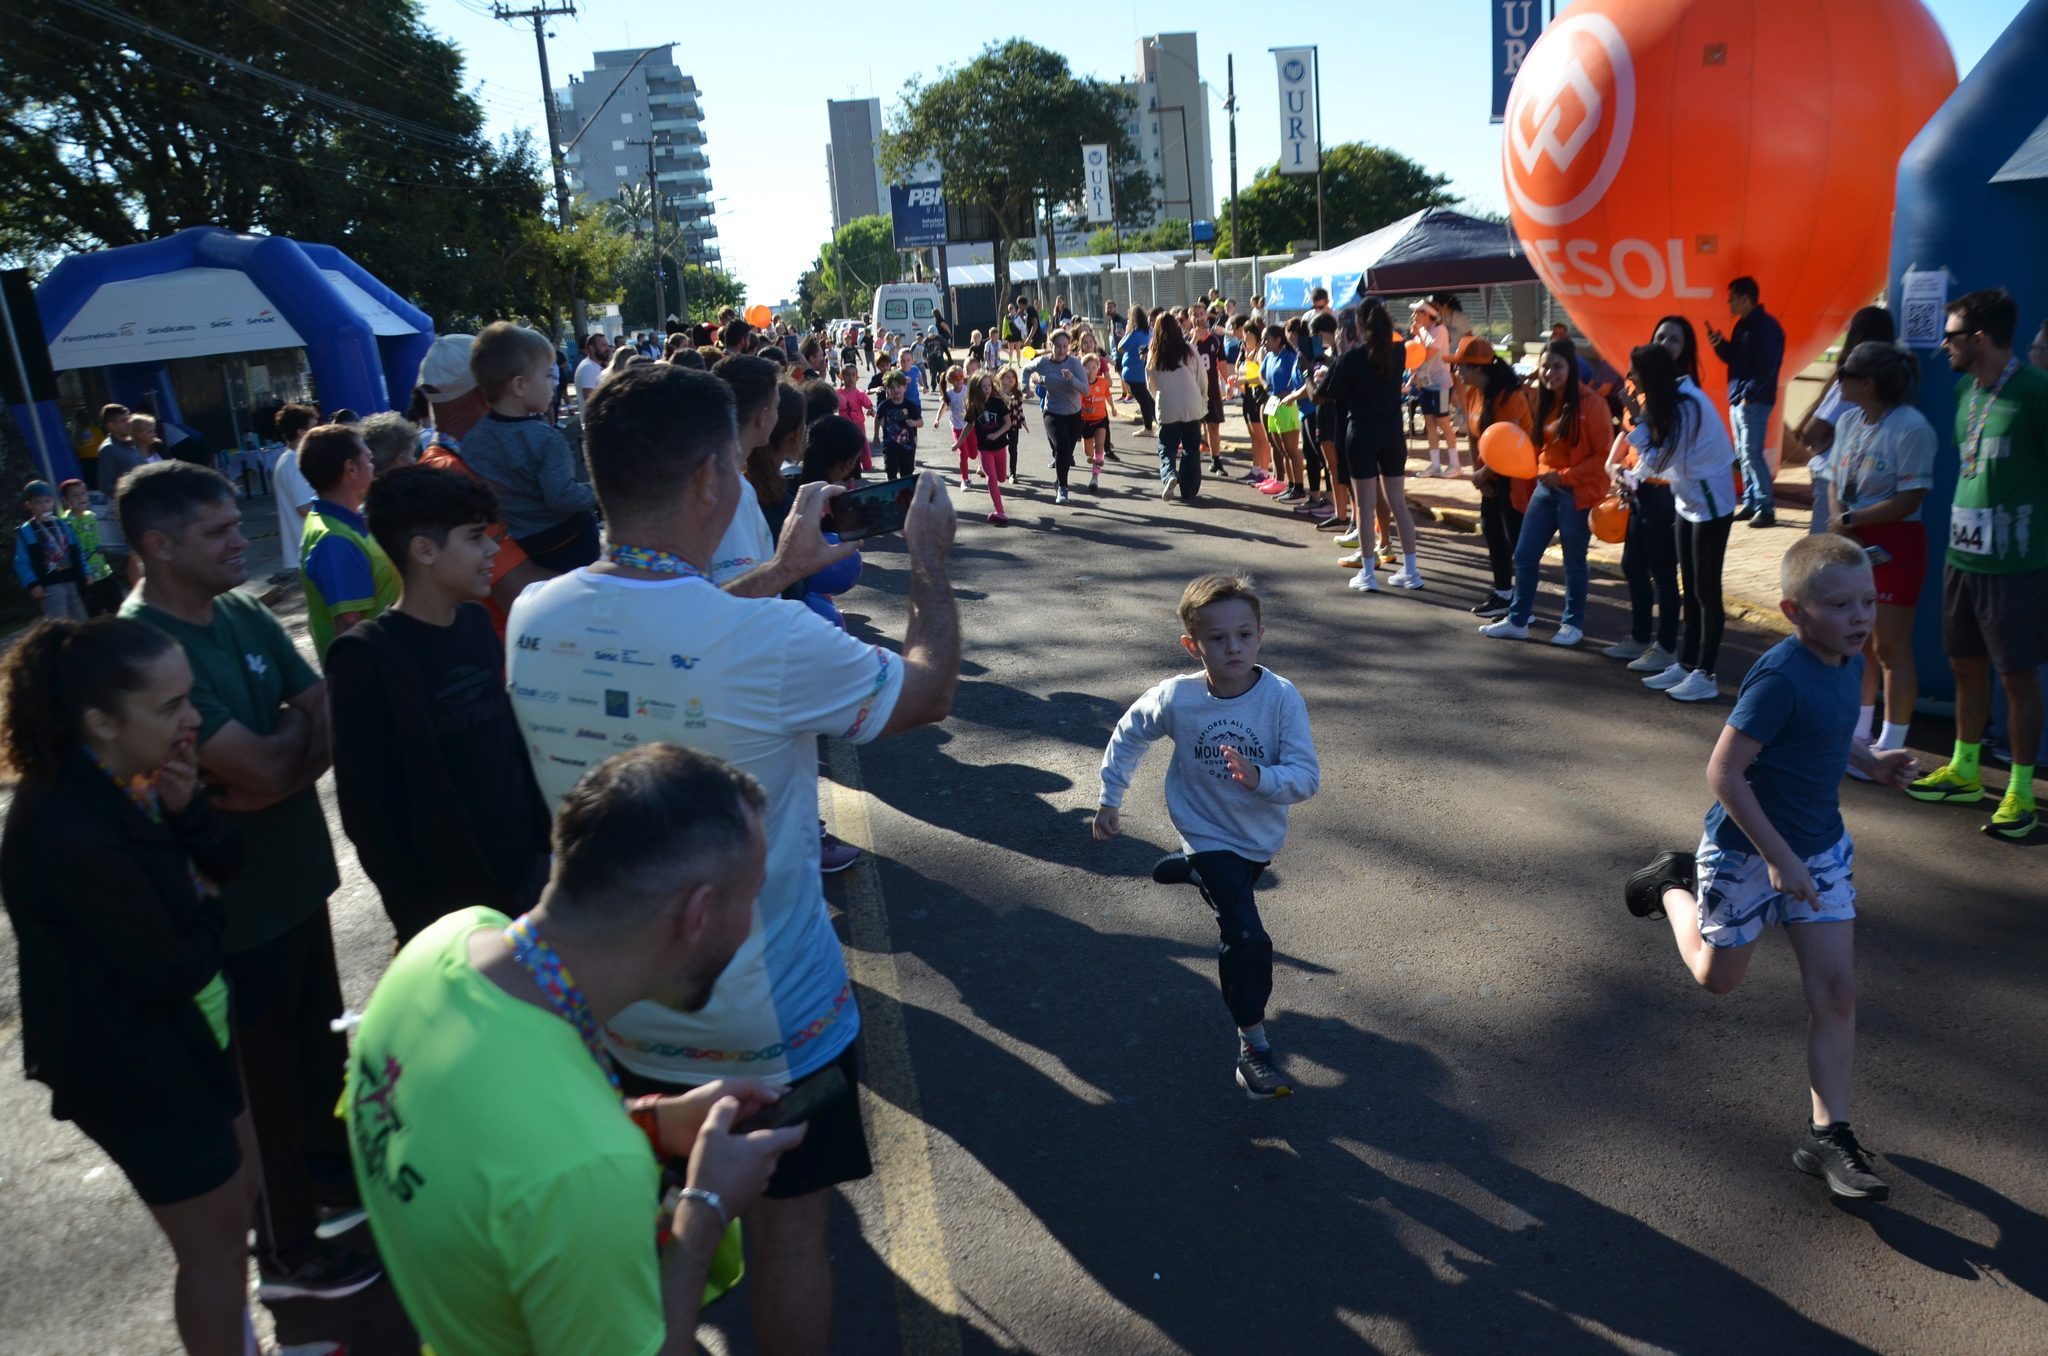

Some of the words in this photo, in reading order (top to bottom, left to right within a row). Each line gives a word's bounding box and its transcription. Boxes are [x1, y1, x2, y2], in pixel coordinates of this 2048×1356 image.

[1502, 0, 1533, 82] UR
[1285, 90, 1307, 165] URI
[1090, 170, 1104, 216] URI
[888, 286, 930, 295] AMBULÂNCIA
[61, 331, 118, 343] Fecomércio
[147, 323, 197, 335] Sindicatos
[210, 319, 233, 329] Sesc
[246, 316, 276, 326] Senac
[1230, 719, 1244, 729] ALL
[1245, 727, 1260, 746] OVER
[1194, 745, 1265, 760] MOUAINS
